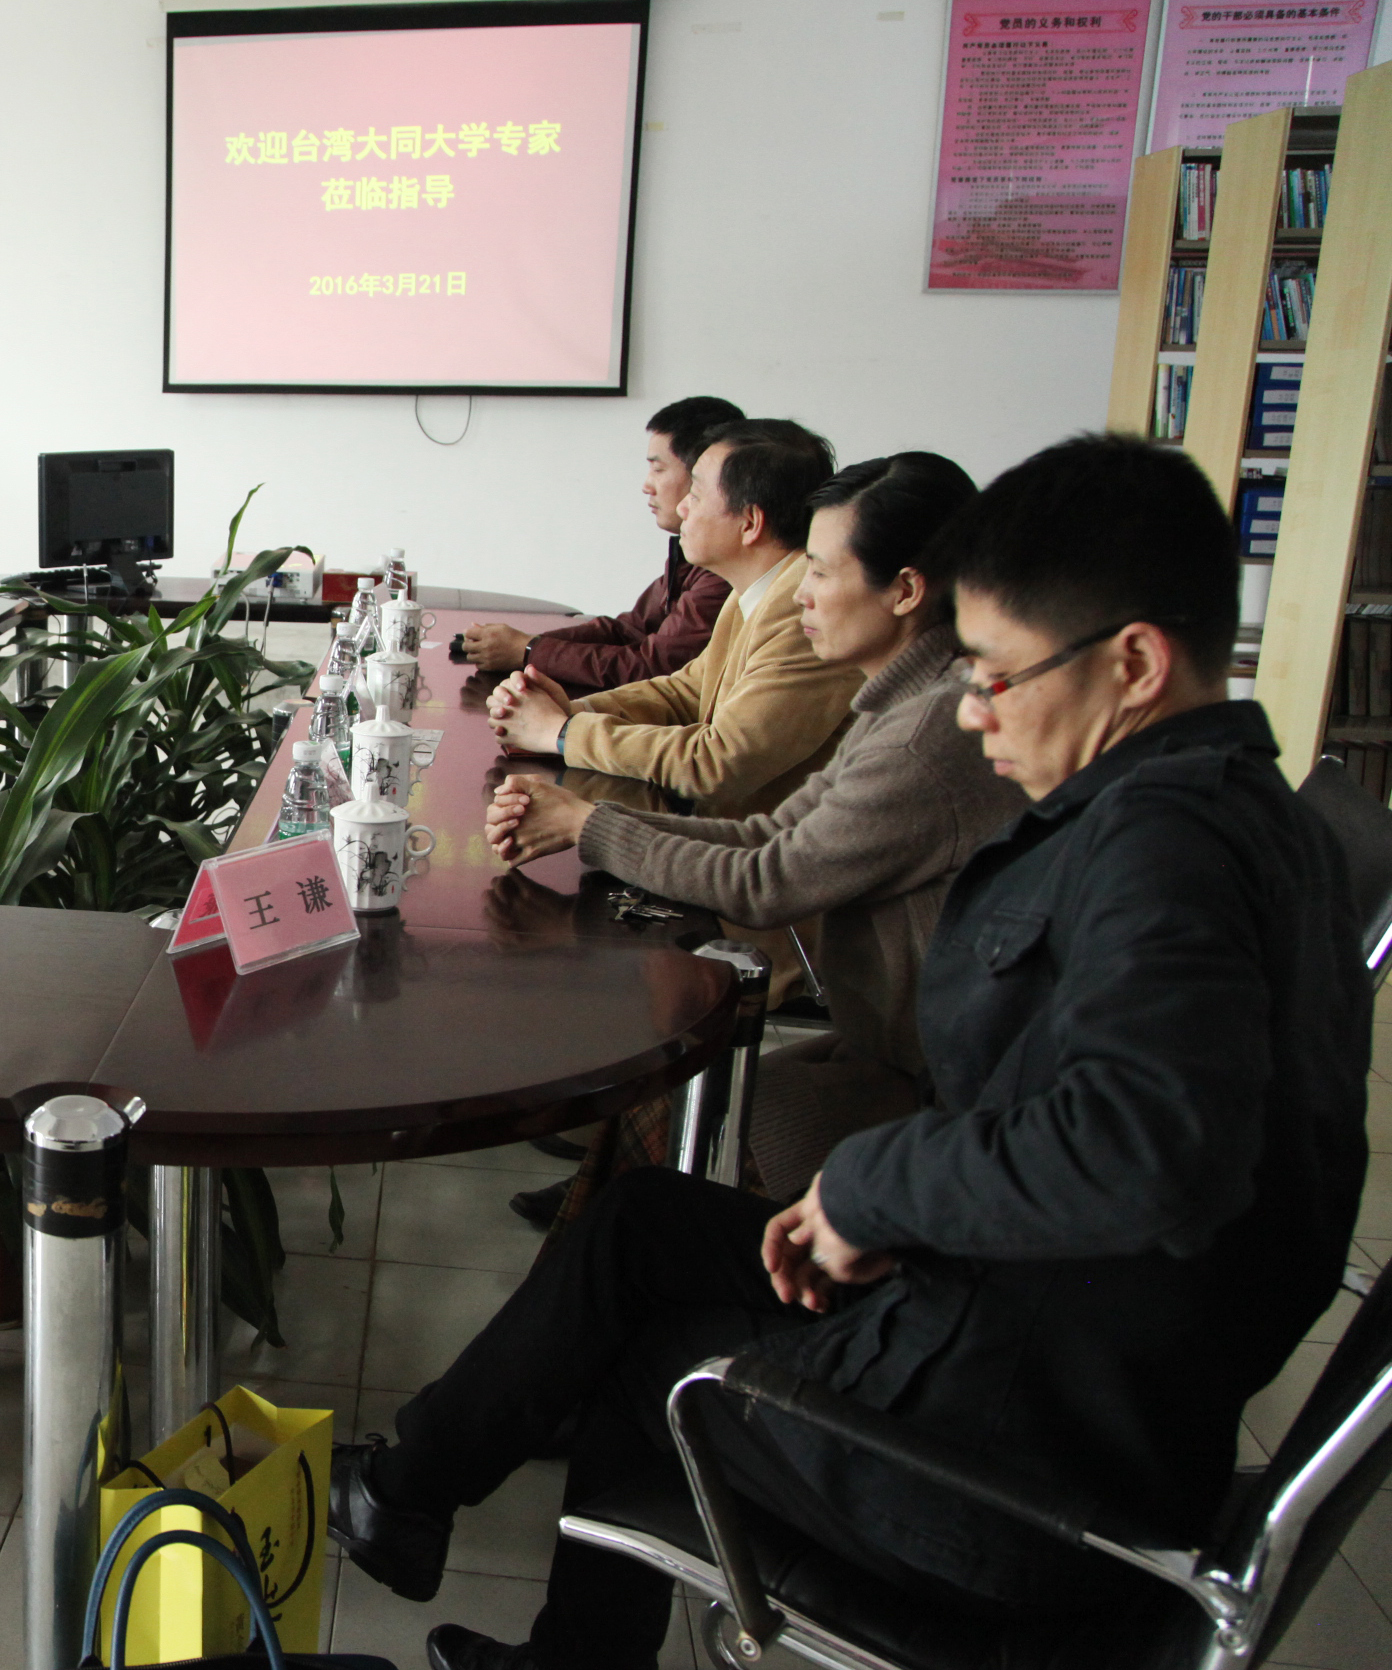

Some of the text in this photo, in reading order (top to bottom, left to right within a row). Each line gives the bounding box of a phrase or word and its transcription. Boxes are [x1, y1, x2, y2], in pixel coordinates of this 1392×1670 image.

[999, 16, 1102, 30] 党员的义务和权利
[1200, 7, 1341, 22] 党的干部必须具备的基本条件
[224, 120, 563, 165] 欢迎台湾大同大学专家
[321, 175, 456, 211] 莅临指导
[308, 271, 468, 297] 2016年3月21日
[243, 875, 334, 930] 王谦
